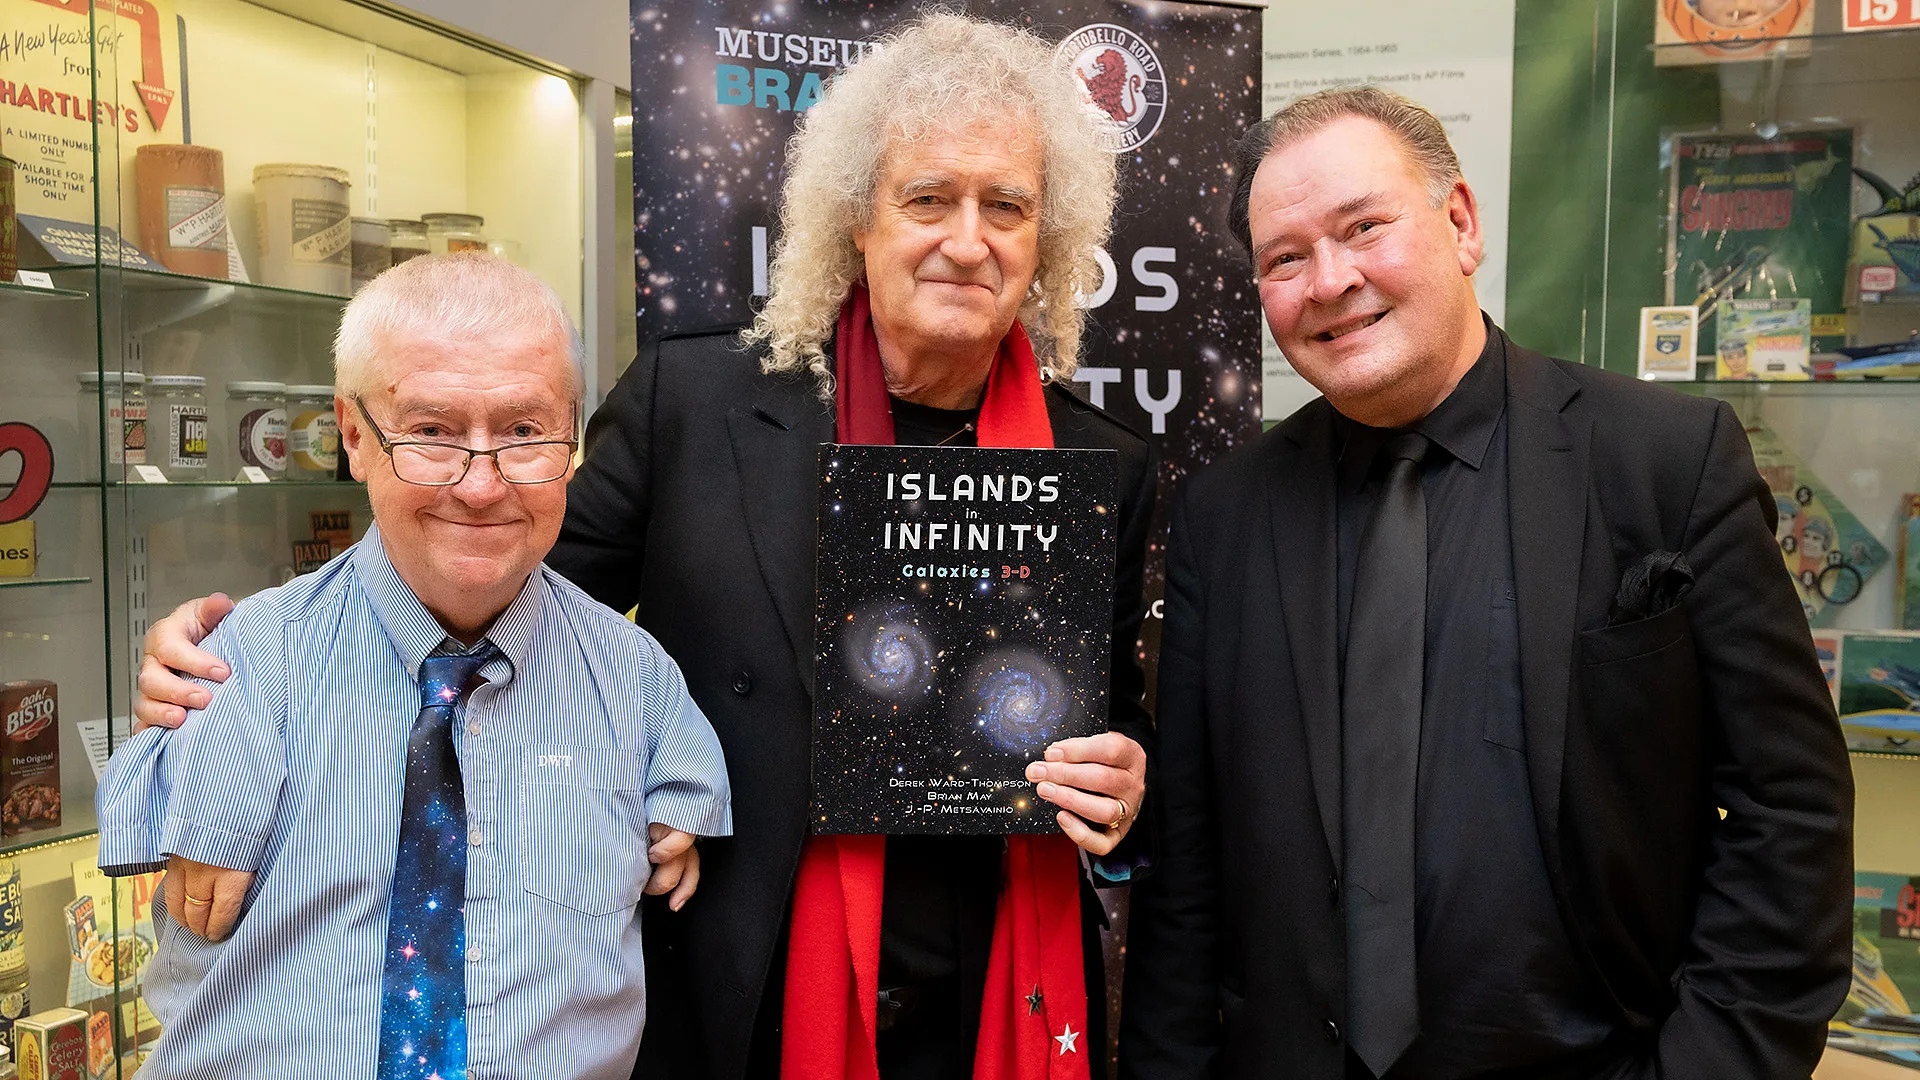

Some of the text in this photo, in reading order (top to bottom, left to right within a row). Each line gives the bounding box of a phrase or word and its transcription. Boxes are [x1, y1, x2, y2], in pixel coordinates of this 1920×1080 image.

[15, 29, 46, 62] New
[1061, 28, 1157, 73] ORTOBELLO ROAD
[0, 78, 139, 133] HARTLEY'S
[6, 127, 14, 136] A
[19, 129, 59, 145] LIMITED
[40, 145, 65, 158] ONLY
[25, 174, 86, 194] SHORT TIME
[65, 171, 85, 182] FOR
[42, 189, 68, 201] ONLY
[886, 473, 1060, 503] ISLANDS
[965, 507, 978, 519] in
[884, 522, 1058, 552] INFINITY
[295, 544, 330, 572] PAXO
[902, 564, 1031, 579] Galaxies 3-D
[6, 697, 55, 736] BISTO
[12, 752, 54, 766] The Original
[538, 755, 572, 767] DWT
[889, 778, 1032, 789] DEREK WARD-THOMPSON
[927, 791, 993, 801] BRIAN MAY
[940, 804, 1014, 815] METSAVAINIO
[51, 1035, 84, 1051] Cerebos
[49, 1045, 85, 1065] Celery
[58, 1059, 80, 1073] SALT
